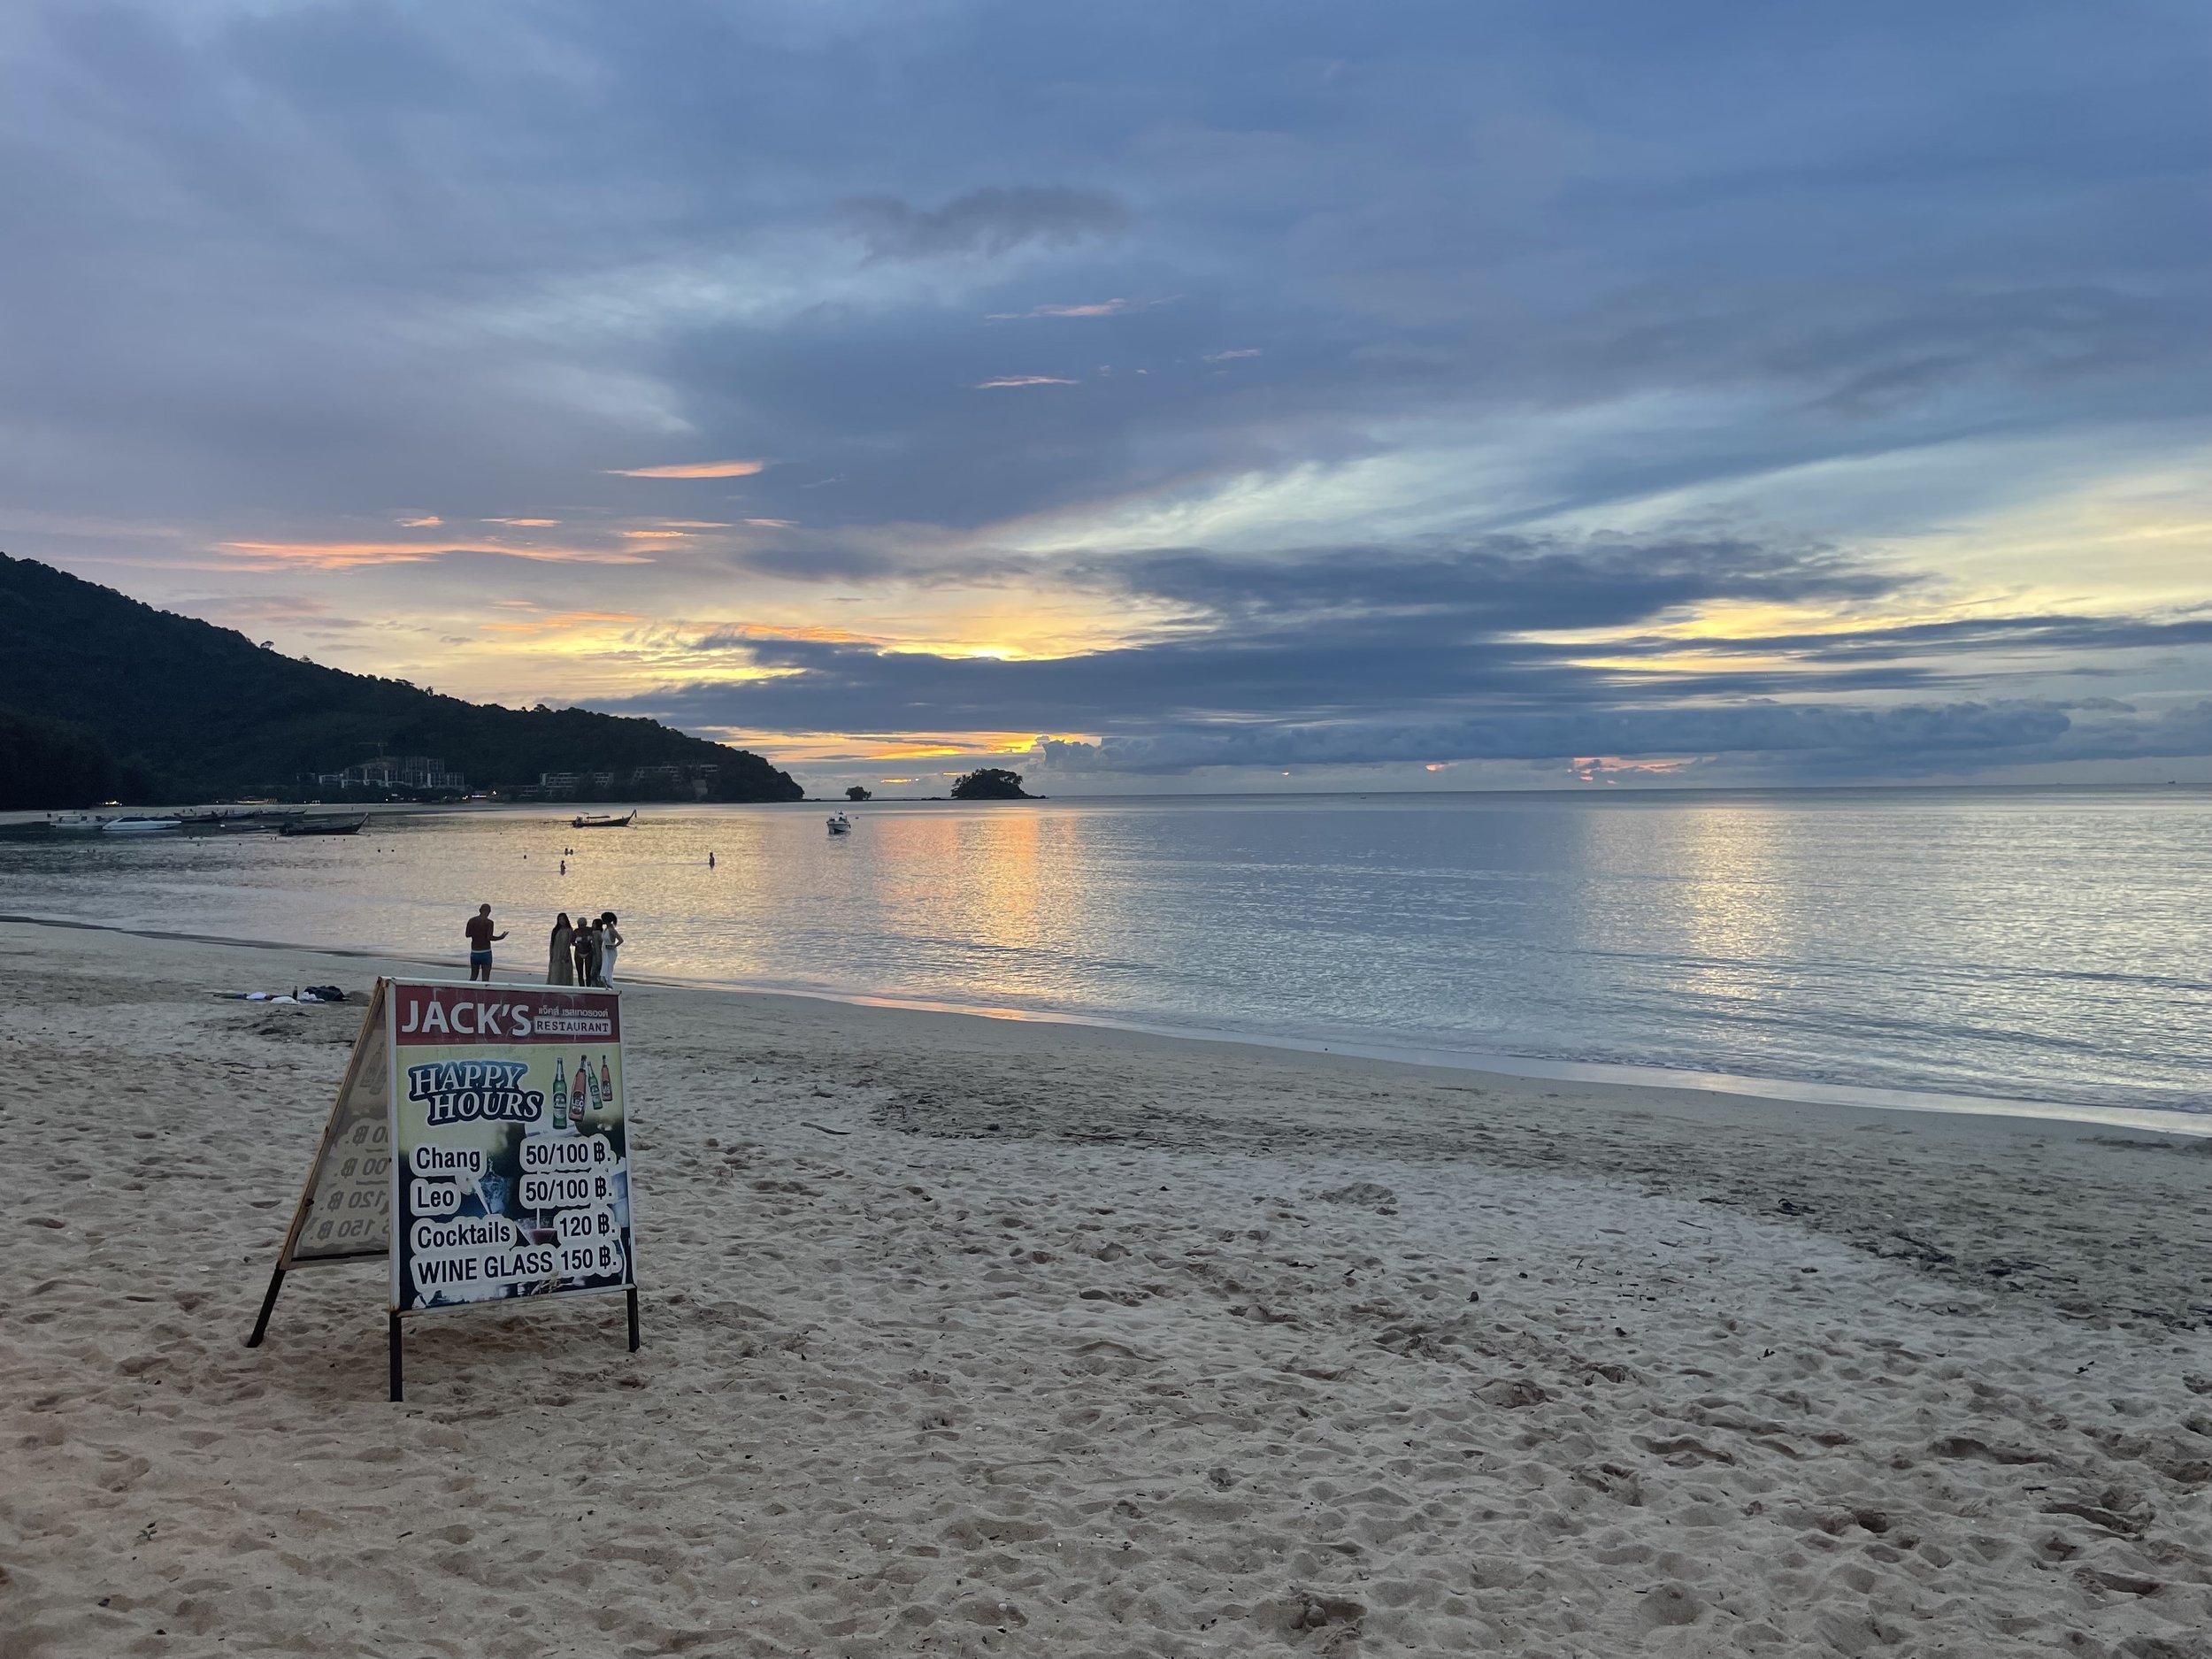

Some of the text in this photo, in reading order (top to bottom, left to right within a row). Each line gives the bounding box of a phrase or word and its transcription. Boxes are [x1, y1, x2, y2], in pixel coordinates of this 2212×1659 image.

[401, 1000, 532, 1036] JACK'S
[536, 1020, 609, 1033] RESTAURANT
[412, 1064, 527, 1097] HAPPY
[431, 1091, 541, 1122] HOURS
[416, 1147, 480, 1172] Chang
[526, 1141, 588, 1165] 50/100
[417, 1186, 455, 1209] Leo
[525, 1179, 588, 1202] 50/100
[418, 1221, 511, 1248] Cocktails
[559, 1216, 592, 1238] 120
[418, 1257, 478, 1285] WINE
[484, 1251, 553, 1279] GLASS
[560, 1248, 594, 1271] 150
